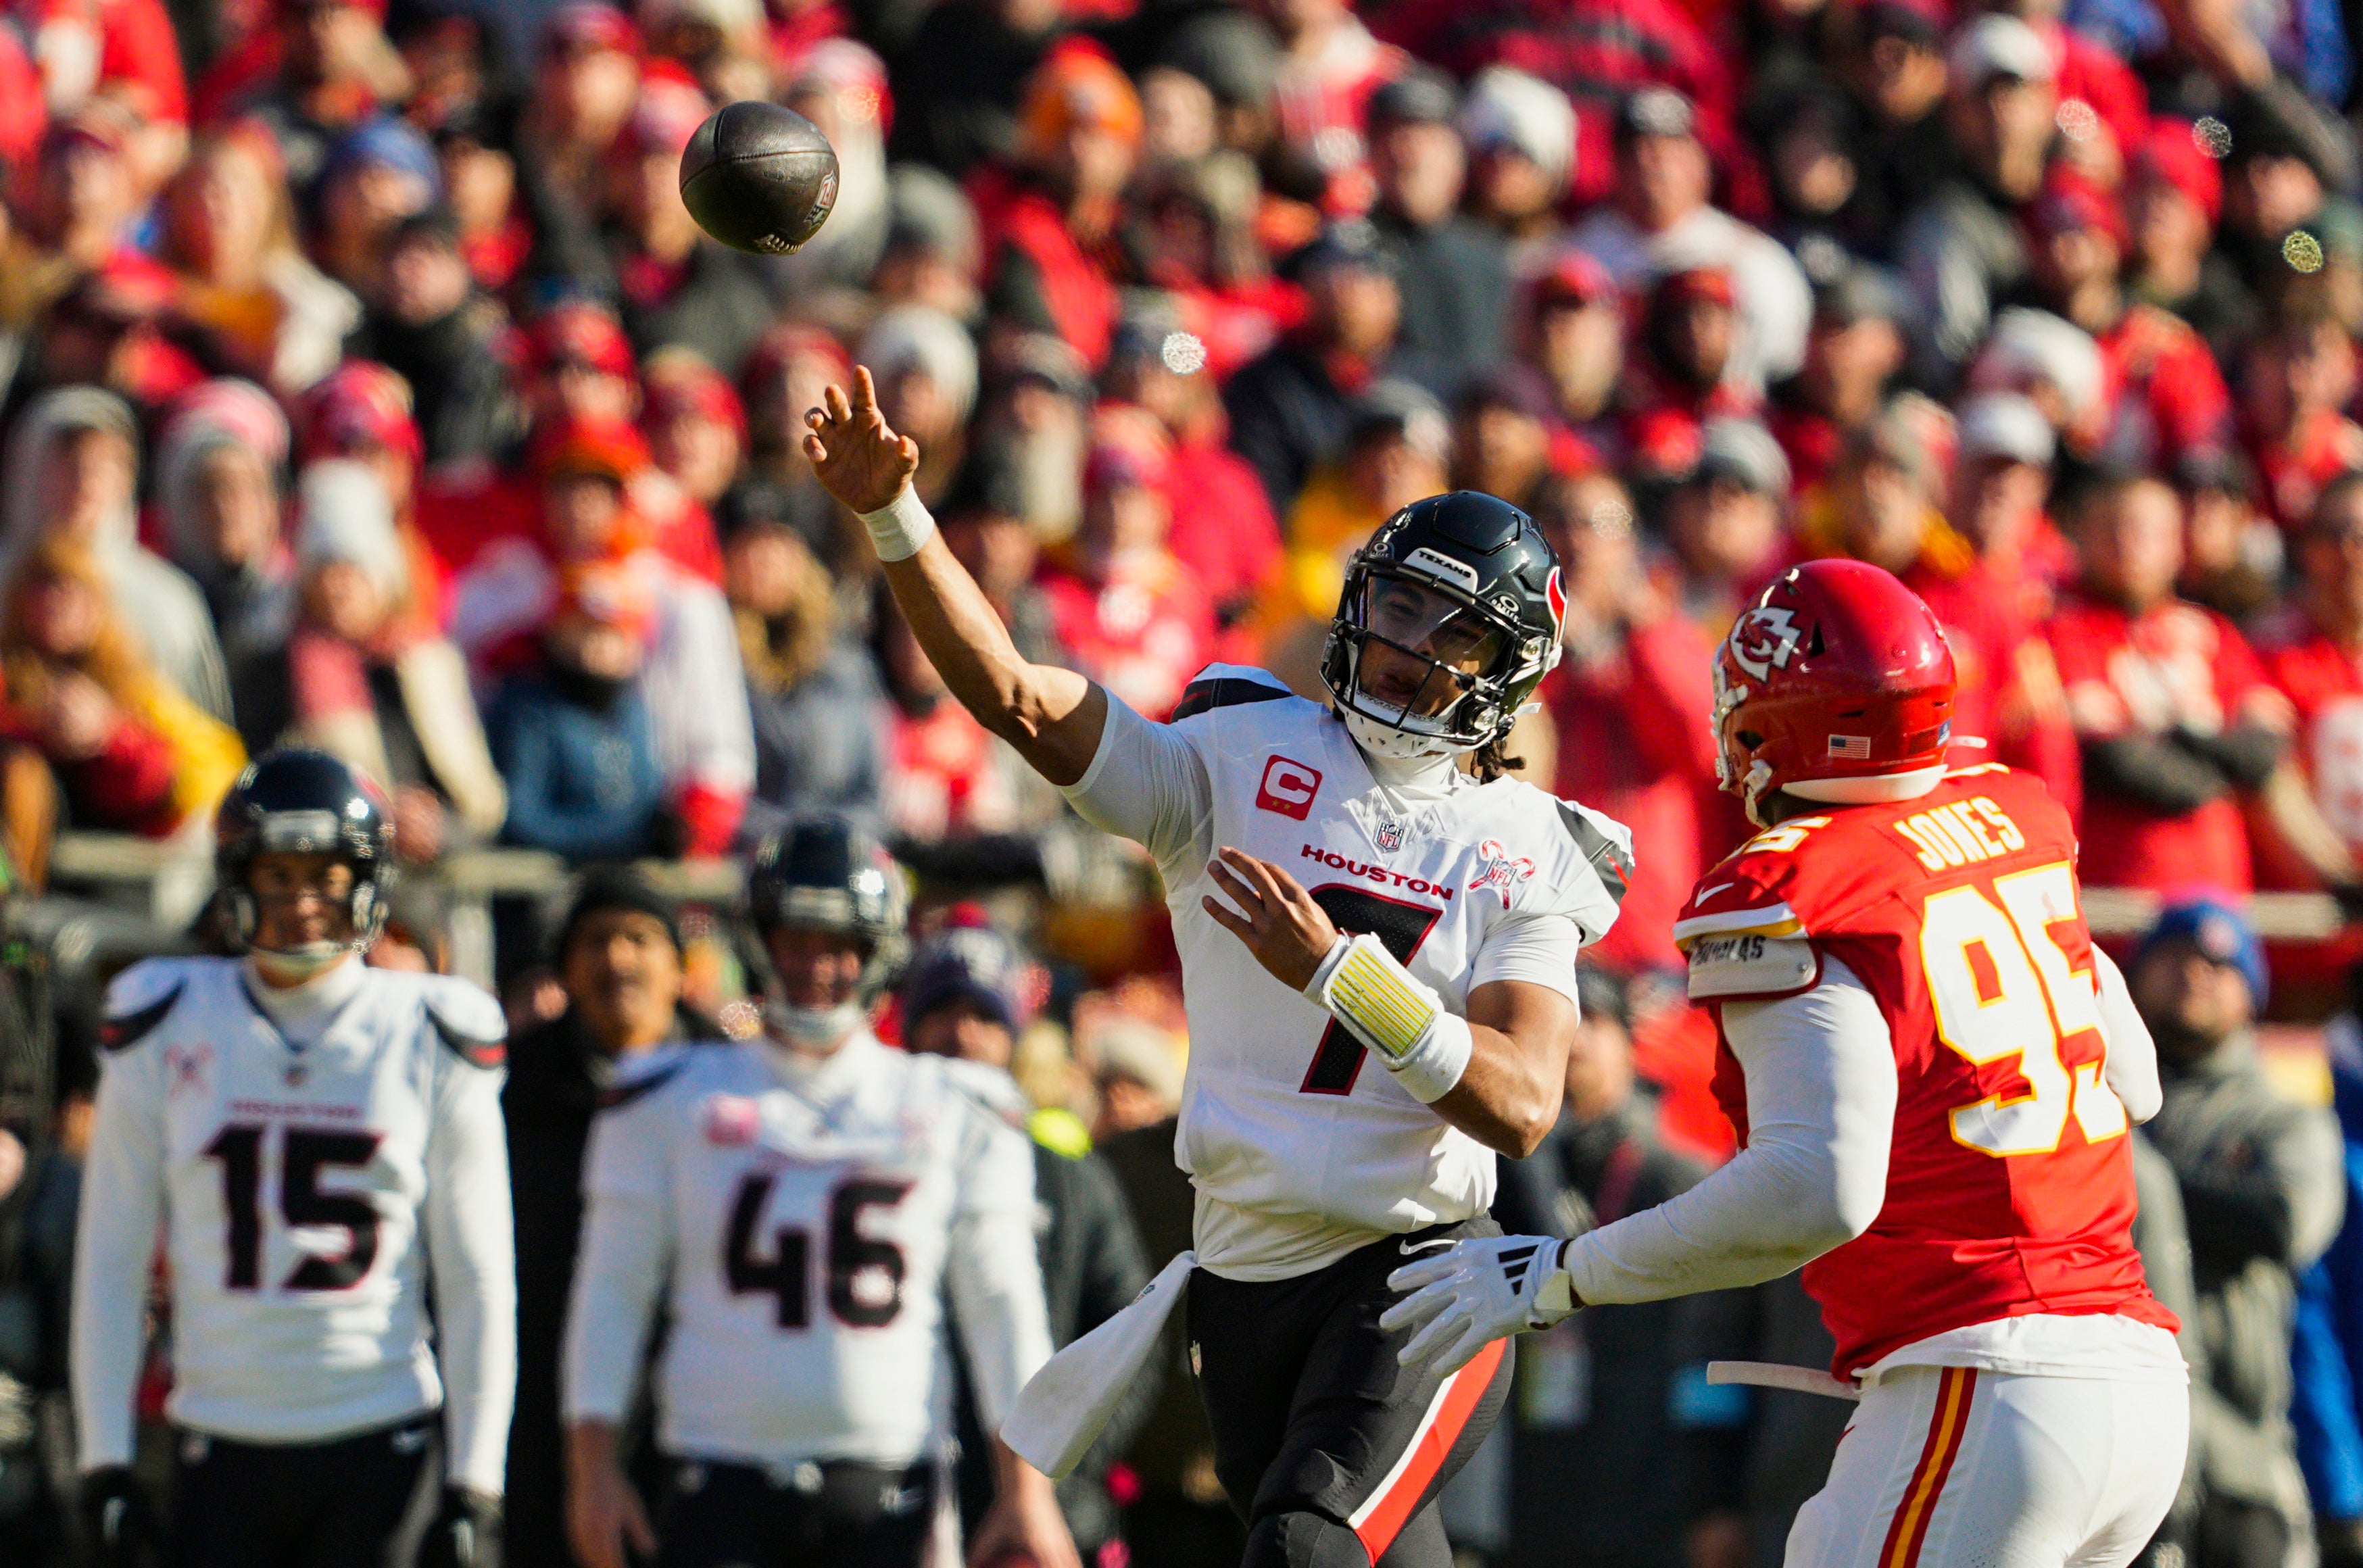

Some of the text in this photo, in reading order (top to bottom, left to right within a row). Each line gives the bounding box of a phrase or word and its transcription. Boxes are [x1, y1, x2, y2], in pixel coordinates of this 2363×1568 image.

[1419, 549, 1472, 579] TEXANS
[1265, 760, 1316, 804] C
[1378, 831, 1398, 848] NFL
[1893, 795, 2026, 872] JONES
[1300, 843, 1454, 900] HOUSTON
[1488, 868, 1509, 887] NFL
[1298, 882, 1444, 1096] 7
[1920, 860, 2128, 1158] 95
[203, 1123, 385, 1290] 15
[725, 1171, 915, 1329] 46
